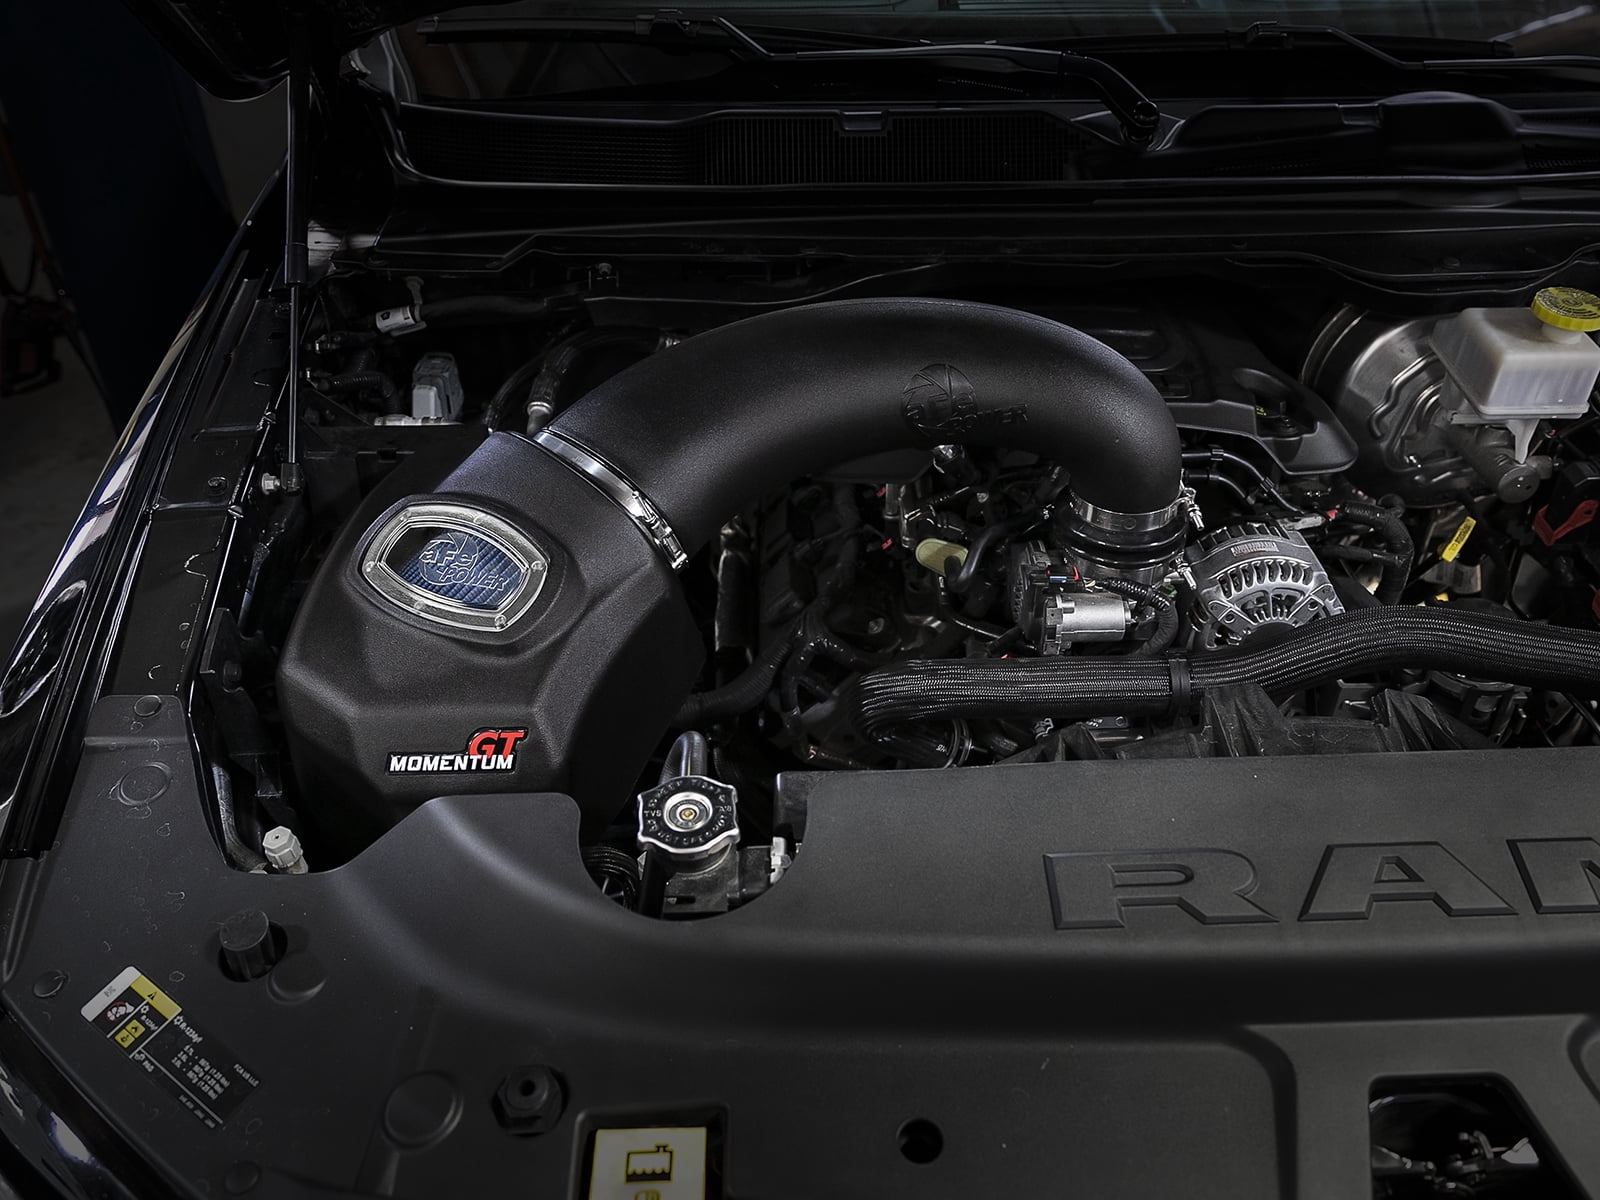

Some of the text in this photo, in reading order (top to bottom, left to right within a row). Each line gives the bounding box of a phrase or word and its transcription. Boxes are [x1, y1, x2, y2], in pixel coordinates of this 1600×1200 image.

[438, 566, 509, 591] POWER
[467, 730, 526, 760] GT
[388, 754, 514, 772] MOMENTUM
